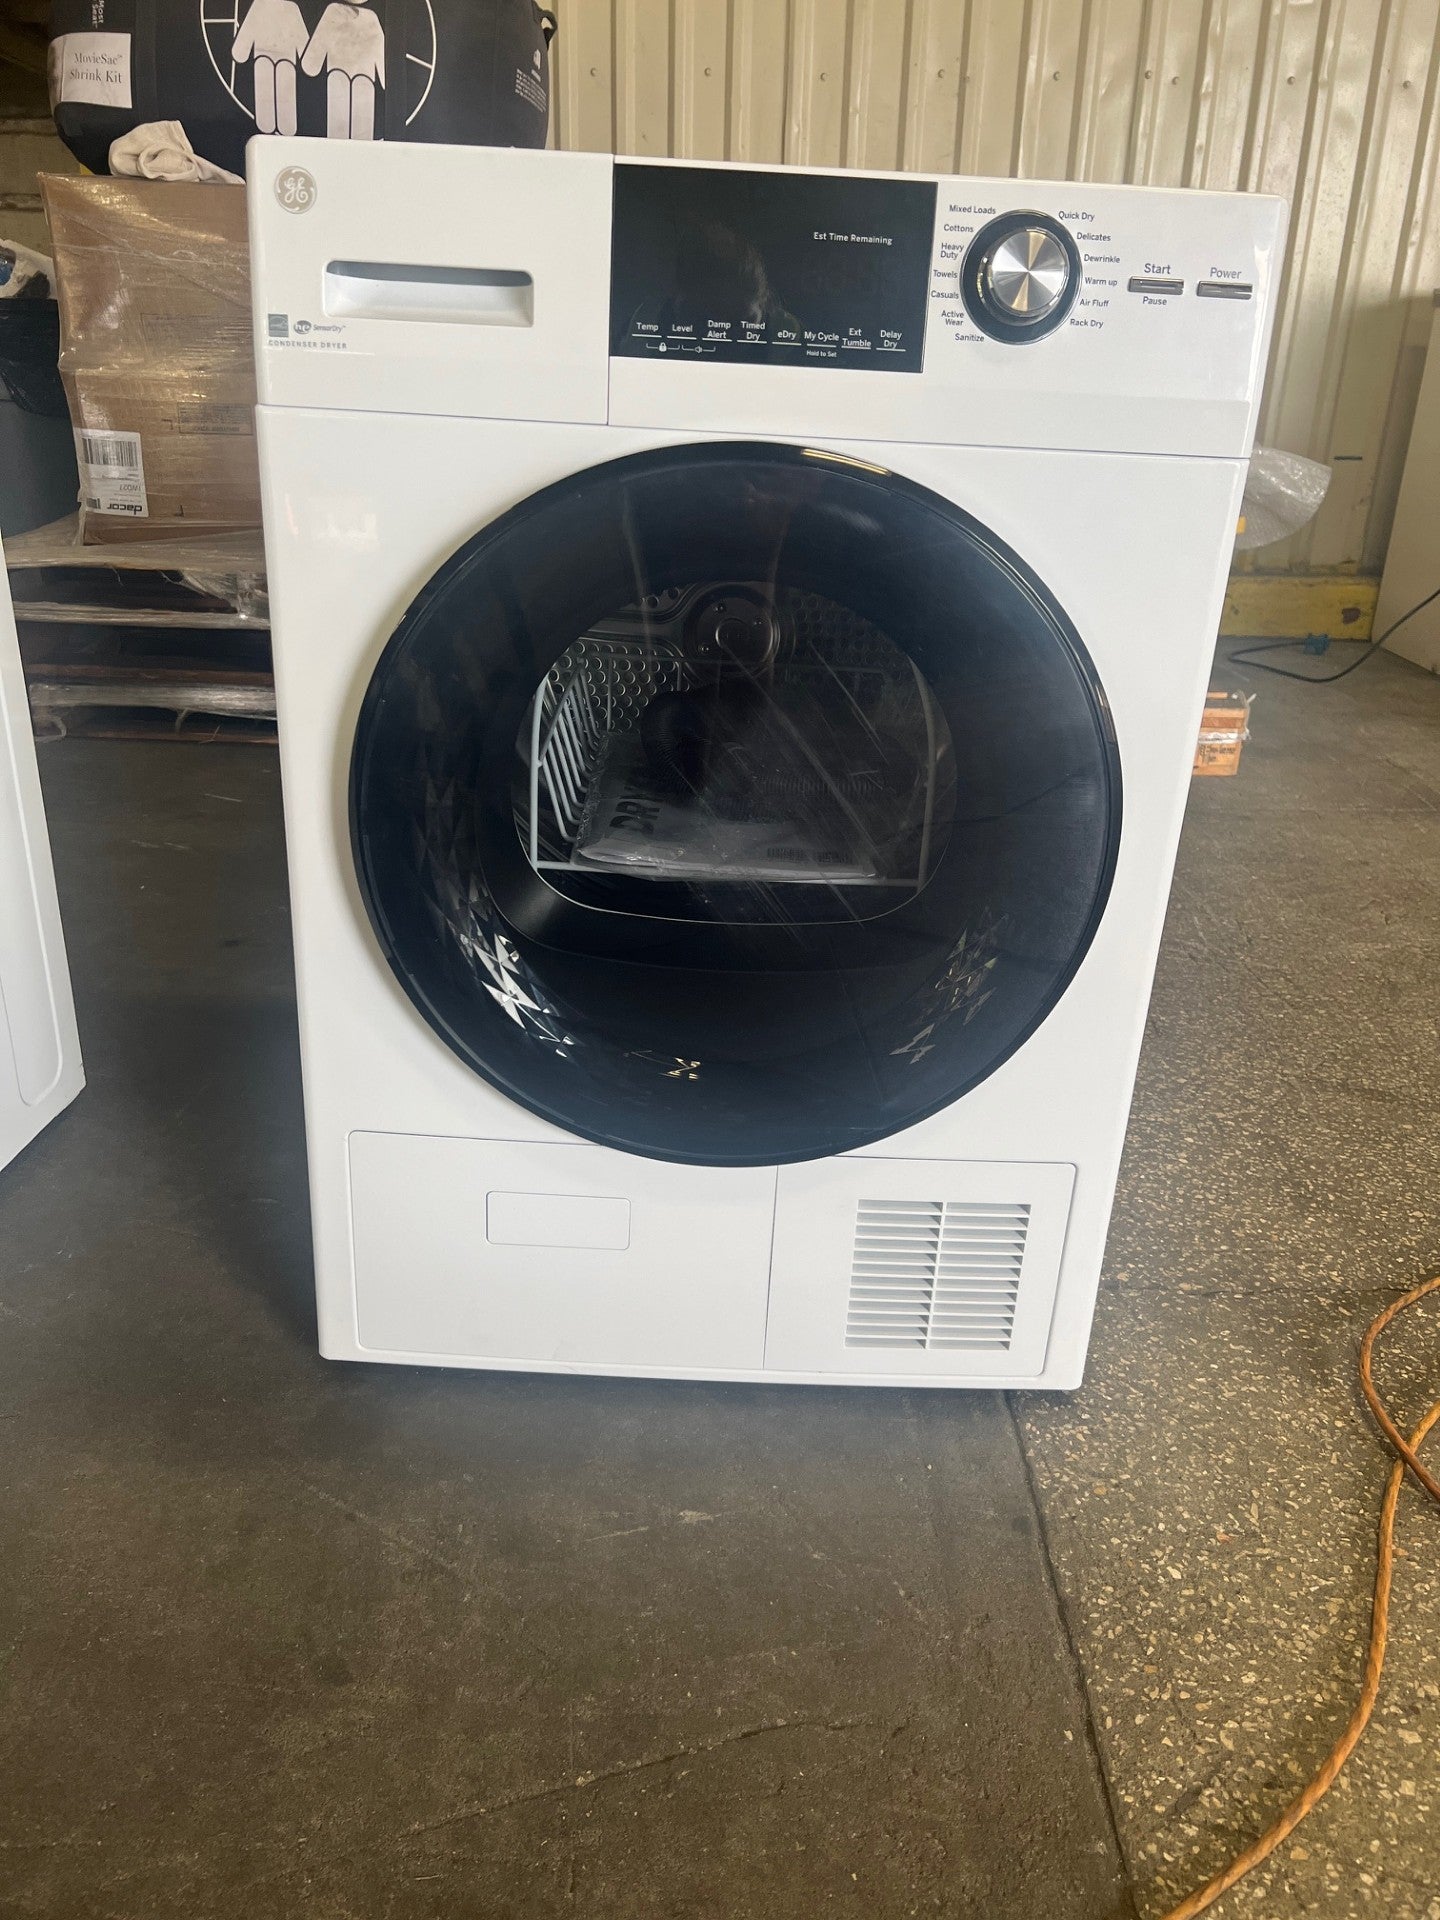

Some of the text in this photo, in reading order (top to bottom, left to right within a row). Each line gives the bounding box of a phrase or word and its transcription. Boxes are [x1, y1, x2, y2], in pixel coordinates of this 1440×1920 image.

[70, 68, 122, 84] Shrink Kit
[949, 204, 996, 215] Mixed Loads
[1058, 210, 1095, 222] Quick Dry
[944, 224, 974, 234] Cottons
[814, 232, 893, 245] Est Time Remaining
[1076, 232, 1111, 242] Delicates
[941, 242, 964, 253] Heavy
[940, 250, 959, 260] Duty
[1084, 254, 1120, 264] Dewrinkle
[1144, 262, 1171, 275] Start
[1210, 267, 1242, 280] Power
[933, 269, 958, 279] Towels
[1085, 277, 1118, 288] Warm up
[931, 290, 959, 300] Casuals
[1079, 298, 1109, 309] Air Fluff
[1142, 296, 1168, 306] Pause
[941, 310, 964, 319] Active
[708, 320, 731, 330] Damp
[741, 320, 766, 330] Timed
[945, 318, 964, 327] Wear
[1070, 318, 1104, 329] Rack Dry
[637, 323, 659, 333] Temp
[672, 323, 693, 333] Level
[849, 328, 862, 336] Ext
[707, 330, 726, 340] Alert
[746, 331, 761, 342] Dry
[778, 330, 797, 340] eDry
[804, 331, 839, 342] My Cycle
[880, 330, 902, 340] Delay
[954, 333, 984, 342] Sanitize
[268, 340, 317, 348] CONDENSER
[842, 338, 872, 347] Tumble
[884, 339, 898, 349] Dry
[107, 504, 143, 516] dacor
